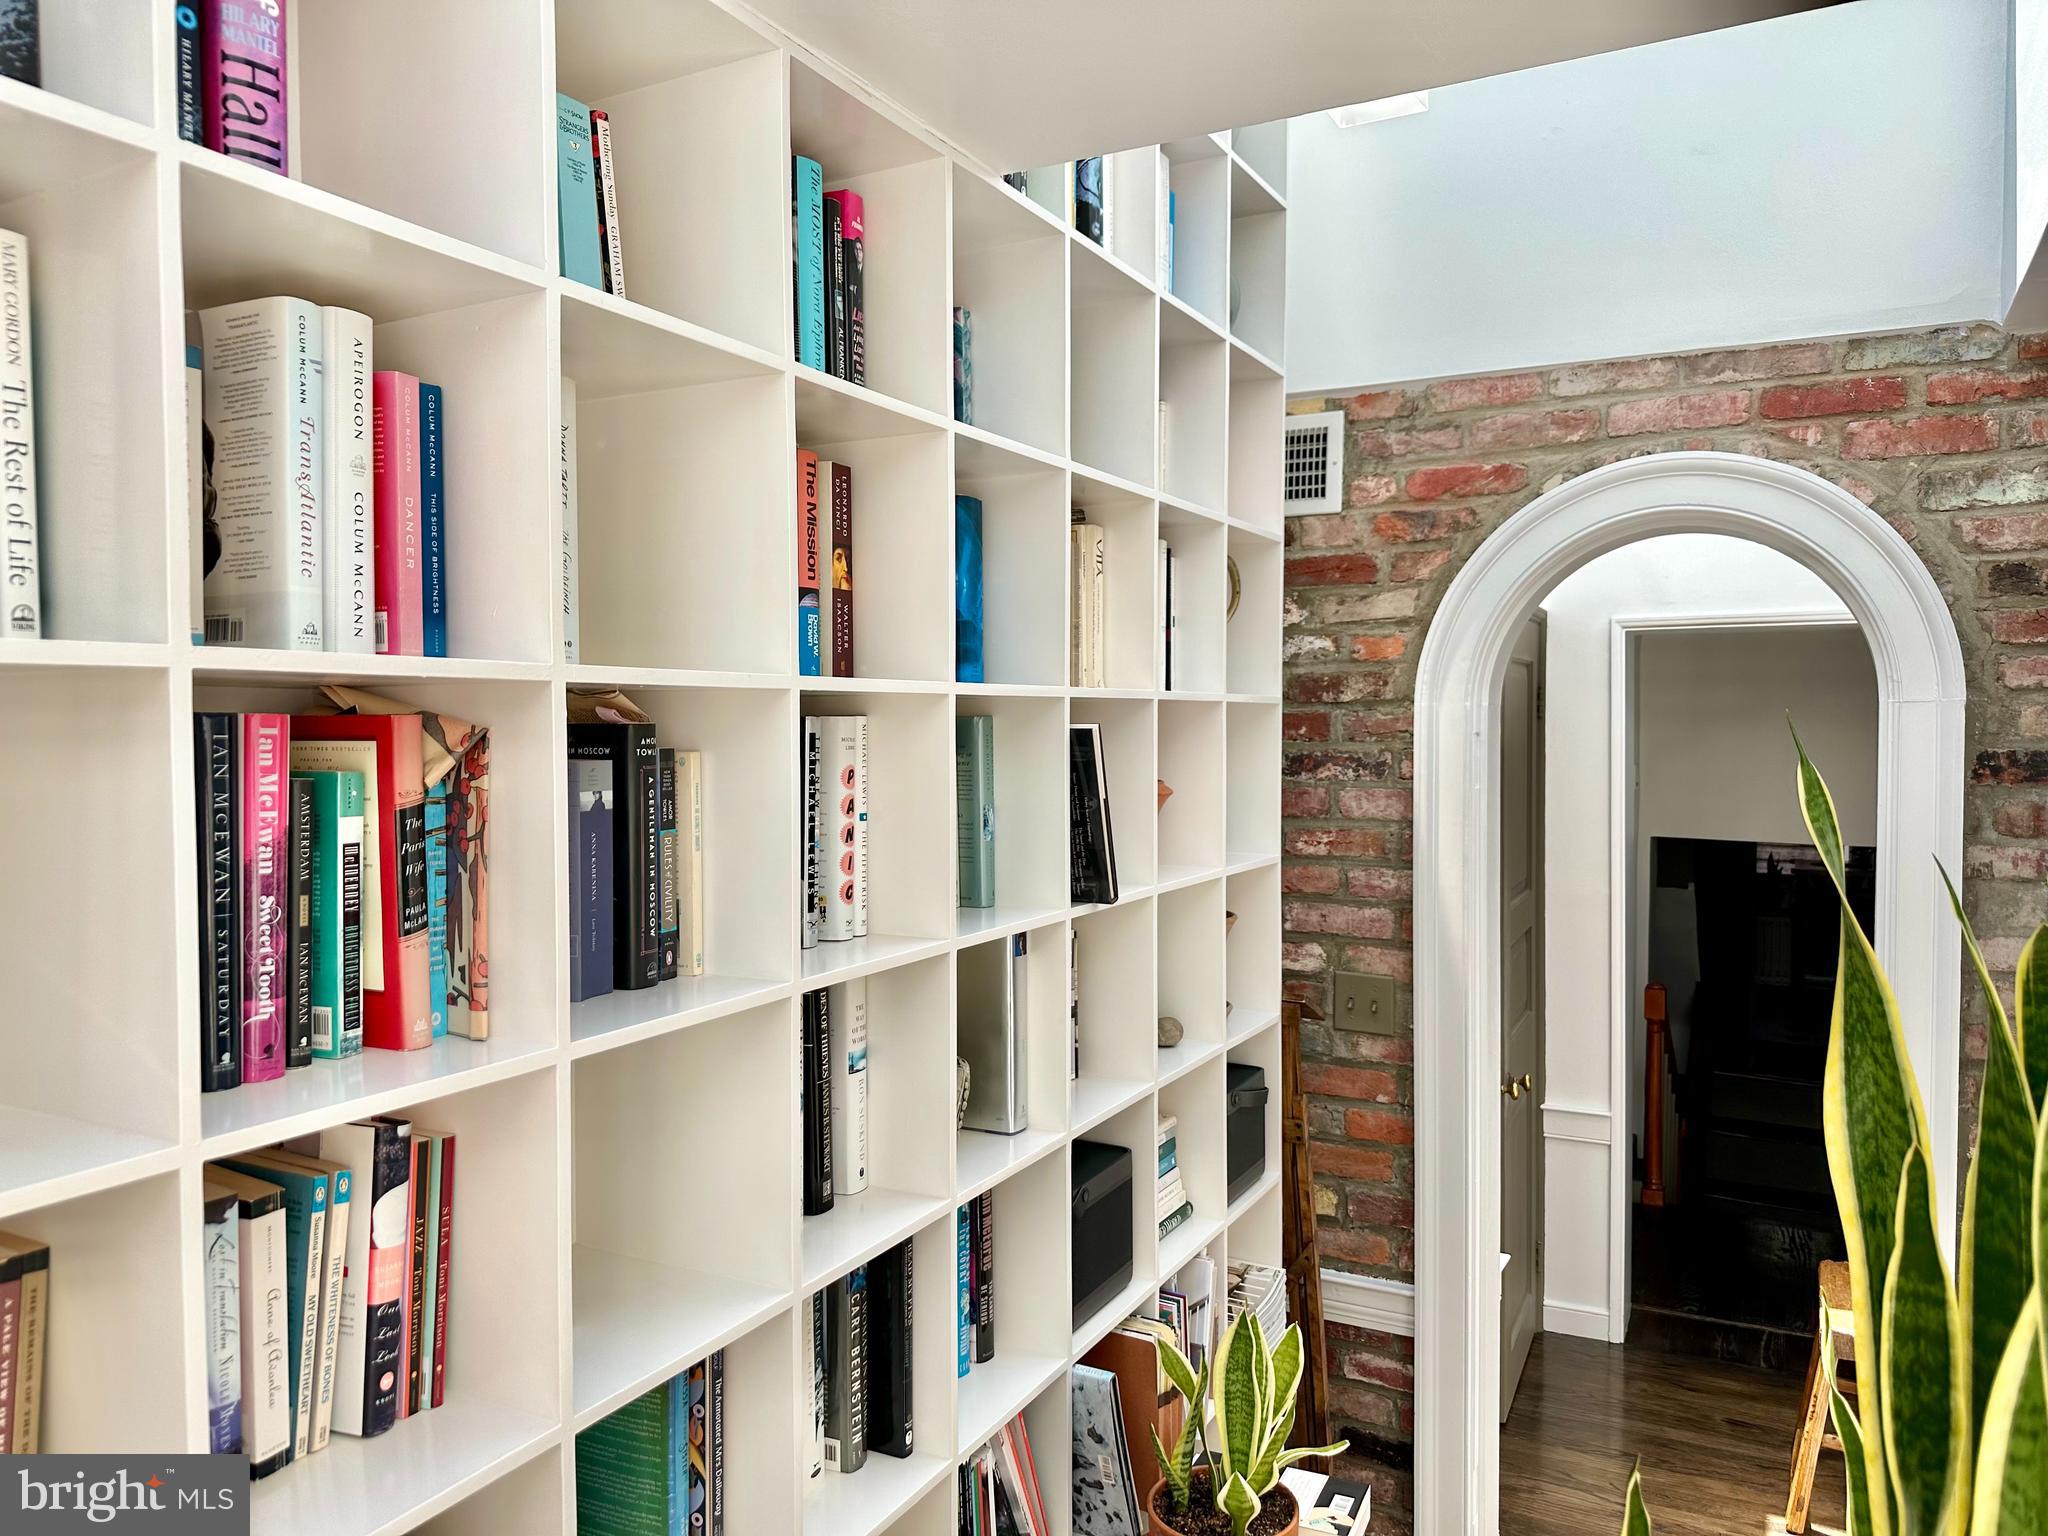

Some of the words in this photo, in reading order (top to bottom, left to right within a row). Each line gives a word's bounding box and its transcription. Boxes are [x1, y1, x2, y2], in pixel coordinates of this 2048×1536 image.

[221, 3, 280, 37] HILARY
[222, 25, 281, 58] MANTEL
[182, 38, 193, 89] HILARY
[183, 91, 194, 139] MANTE
[220, 48, 281, 169] Hall
[559, 116, 589, 135] STRANGERS
[602, 126, 612, 181] Mothering
[811, 166, 820, 195] The
[607, 184, 617, 219] Sunday
[811, 198, 822, 255] MOST
[2, 241, 19, 290] MARY
[611, 226, 621, 277] GRAHAM
[813, 275, 822, 314] Nora
[4, 291, 22, 366] GORDON
[812, 319, 823, 371] Ephro
[299, 358, 307, 404] McCANN
[353, 337, 364, 441] APEIROGON
[3, 380, 28, 430] The
[404, 428, 412, 472] McCANN
[561, 424, 569, 463] DONNA
[4, 439, 30, 492] Rest
[806, 460, 817, 498] The
[295, 416, 317, 578] TransAtlantic
[835, 479, 840, 493] DA
[6, 502, 33, 532] of
[354, 492, 364, 554] COLUM
[405, 497, 415, 569] DANCER
[431, 540, 438, 553] OF
[806, 501, 818, 580] Mission
[8, 538, 35, 587] Life
[354, 563, 364, 638] McCANN
[431, 556, 439, 615] BRIGHTNESS
[213, 735, 229, 778] IAN
[257, 727, 279, 766] Ian
[578, 747, 611, 755] MOSCOW
[640, 737, 656, 745] AMO
[648, 776, 654, 784] A
[808, 751, 816, 829] MICHAEL
[257, 772, 279, 874] McEwan
[300, 793, 310, 880] AMSTERDAM
[405, 816, 423, 831] The
[845, 769, 854, 900] PANIC
[401, 839, 425, 856] Paris
[664, 837, 673, 870] RULES
[405, 859, 425, 877] Wife
[649, 864, 655, 877] IN
[405, 901, 427, 917] PAULA
[665, 879, 673, 922] CIVILITY
[259, 895, 282, 954] Sweet
[404, 914, 428, 930] McLAIN
[299, 942, 309, 966] IAN
[345, 925, 359, 993] BRIGHTNESS
[217, 929, 231, 1037] SATURDAY
[254, 957, 276, 1023] Tooth
[820, 991, 828, 1015] DEN
[345, 996, 360, 1029] FALLS
[821, 1016, 828, 1031] OF
[821, 1034, 830, 1079] THIEVES
[981, 1193, 992, 1215] ohn
[310, 1216, 321, 1252] Susanna
[415, 1217, 424, 1253] JAZZ
[440, 1206, 450, 1246] SULA
[310, 1252, 319, 1280] Moore
[331, 1254, 341, 1279] THE
[413, 1266, 423, 1297] Toni
[438, 1259, 449, 1293] Toni
[4, 1299, 13, 1309] A
[267, 1288, 281, 1328] Anne
[308, 1294, 317, 1311] MY
[377, 1303, 401, 1316] One
[980, 1284, 988, 1295] BE
[214, 1279, 240, 1349] Translation
[305, 1314, 315, 1337] OLD
[326, 1280, 340, 1345] WHITENESS
[373, 1323, 401, 1342] Last
[412, 1300, 422, 1355] Morrison
[436, 1294, 447, 1349] Morrison
[814, 1292, 823, 1353] THARINE
[850, 1292, 861, 1339] CARL
[2, 1314, 13, 1353] PALE
[27, 1318, 36, 1383] REMAINS
[262, 1332, 280, 1346] of
[324, 1347, 334, 1363] OF
[0, 1359, 10, 1400] VIEW
[24, 1386, 32, 1404] OF
[268, 1348, 282, 1409] Avonlea
[300, 1339, 313, 1416] SWEETHEART
[321, 1365, 332, 1405] BONES
[715, 1377, 723, 1394] The
[851, 1347, 862, 1444] BERNSTEIN
[23, 1409, 31, 1437] THE
[715, 1395, 723, 1444] Annotated
[679, 1442, 688, 1480] SISTER
[715, 1445, 723, 1468] Mrs.
[714, 1469, 723, 1516] Dalloway
